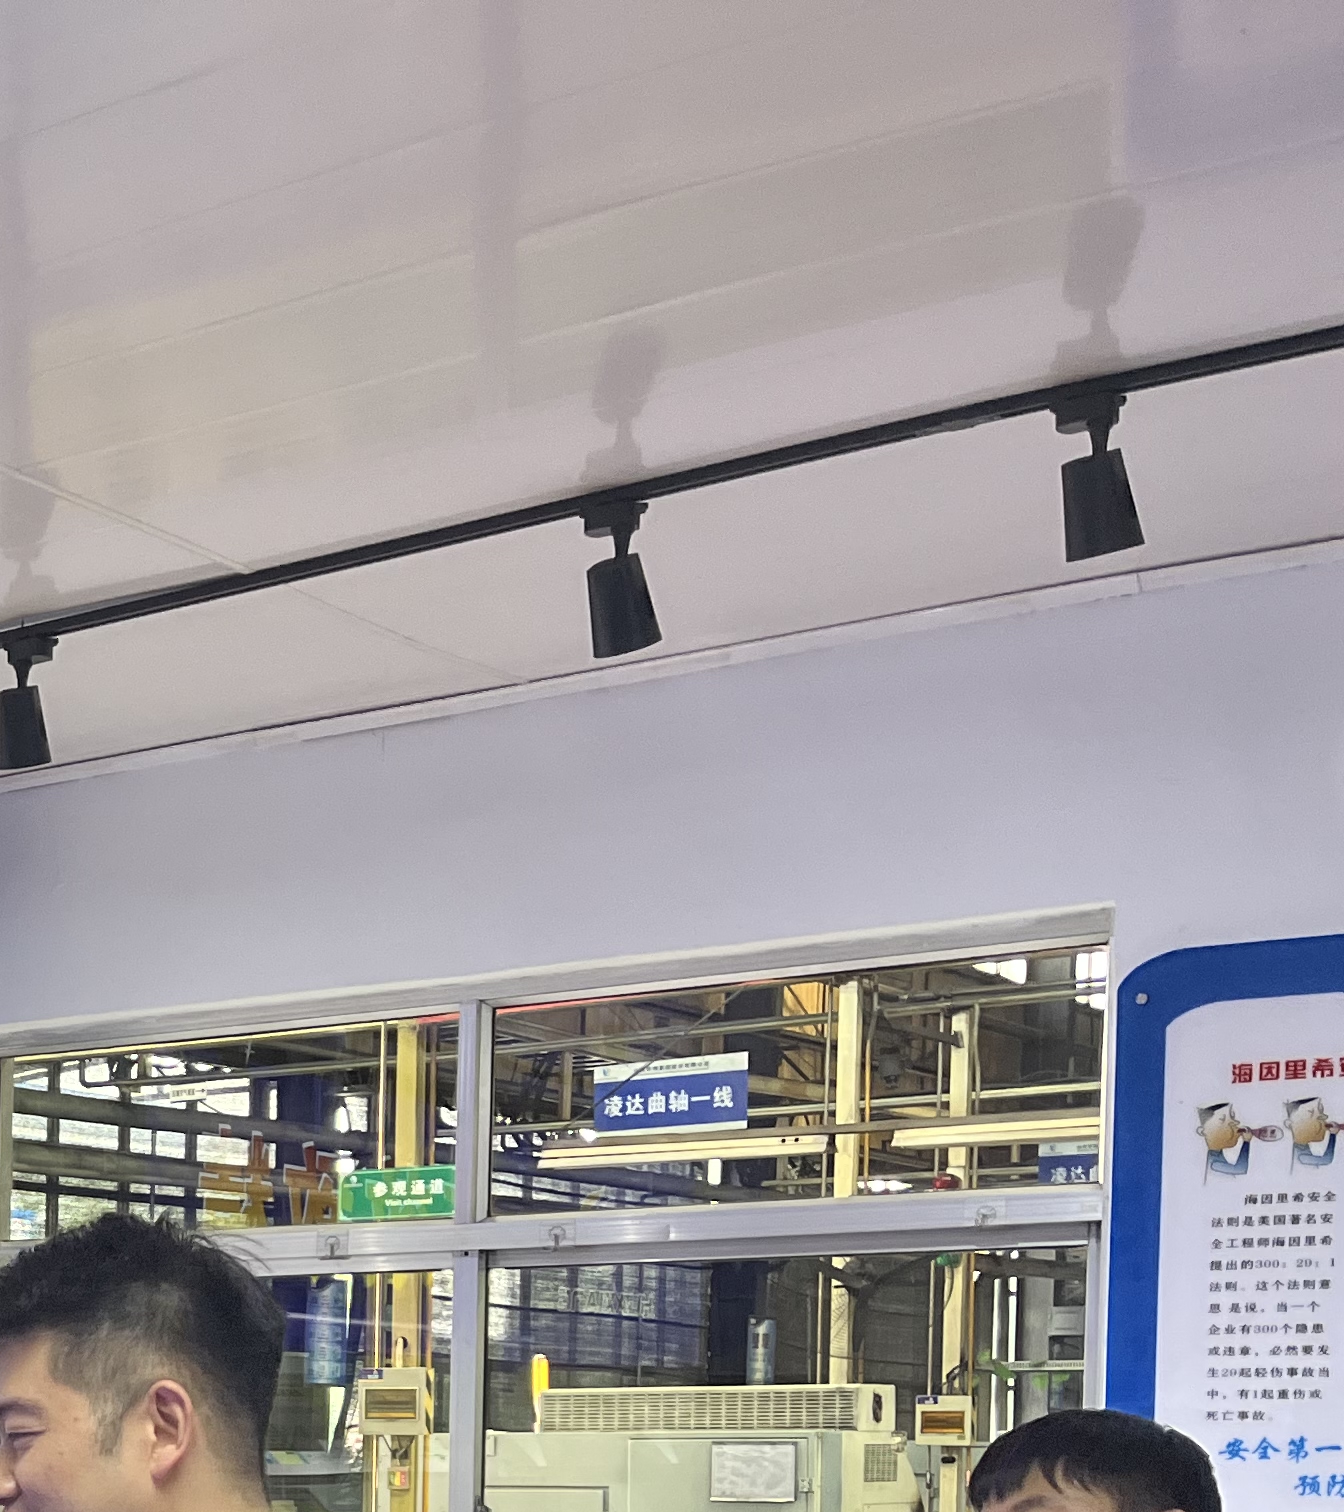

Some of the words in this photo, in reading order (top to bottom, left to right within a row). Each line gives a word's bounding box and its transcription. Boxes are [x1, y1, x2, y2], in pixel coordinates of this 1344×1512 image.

[1231, 1057, 1344, 1084] 海因里希
[603, 1085, 714, 1117] 凌达曲轴一线
[1244, 1191, 1337, 1205] 海因里希安全
[1211, 1213, 1333, 1228] 法则是美国著名安
[1211, 1235, 1333, 1249] 全工程师海因里希
[1208, 1323, 1324, 1335] 企业有300个隐患
[1218, 1435, 1343, 1463] 安全第一
